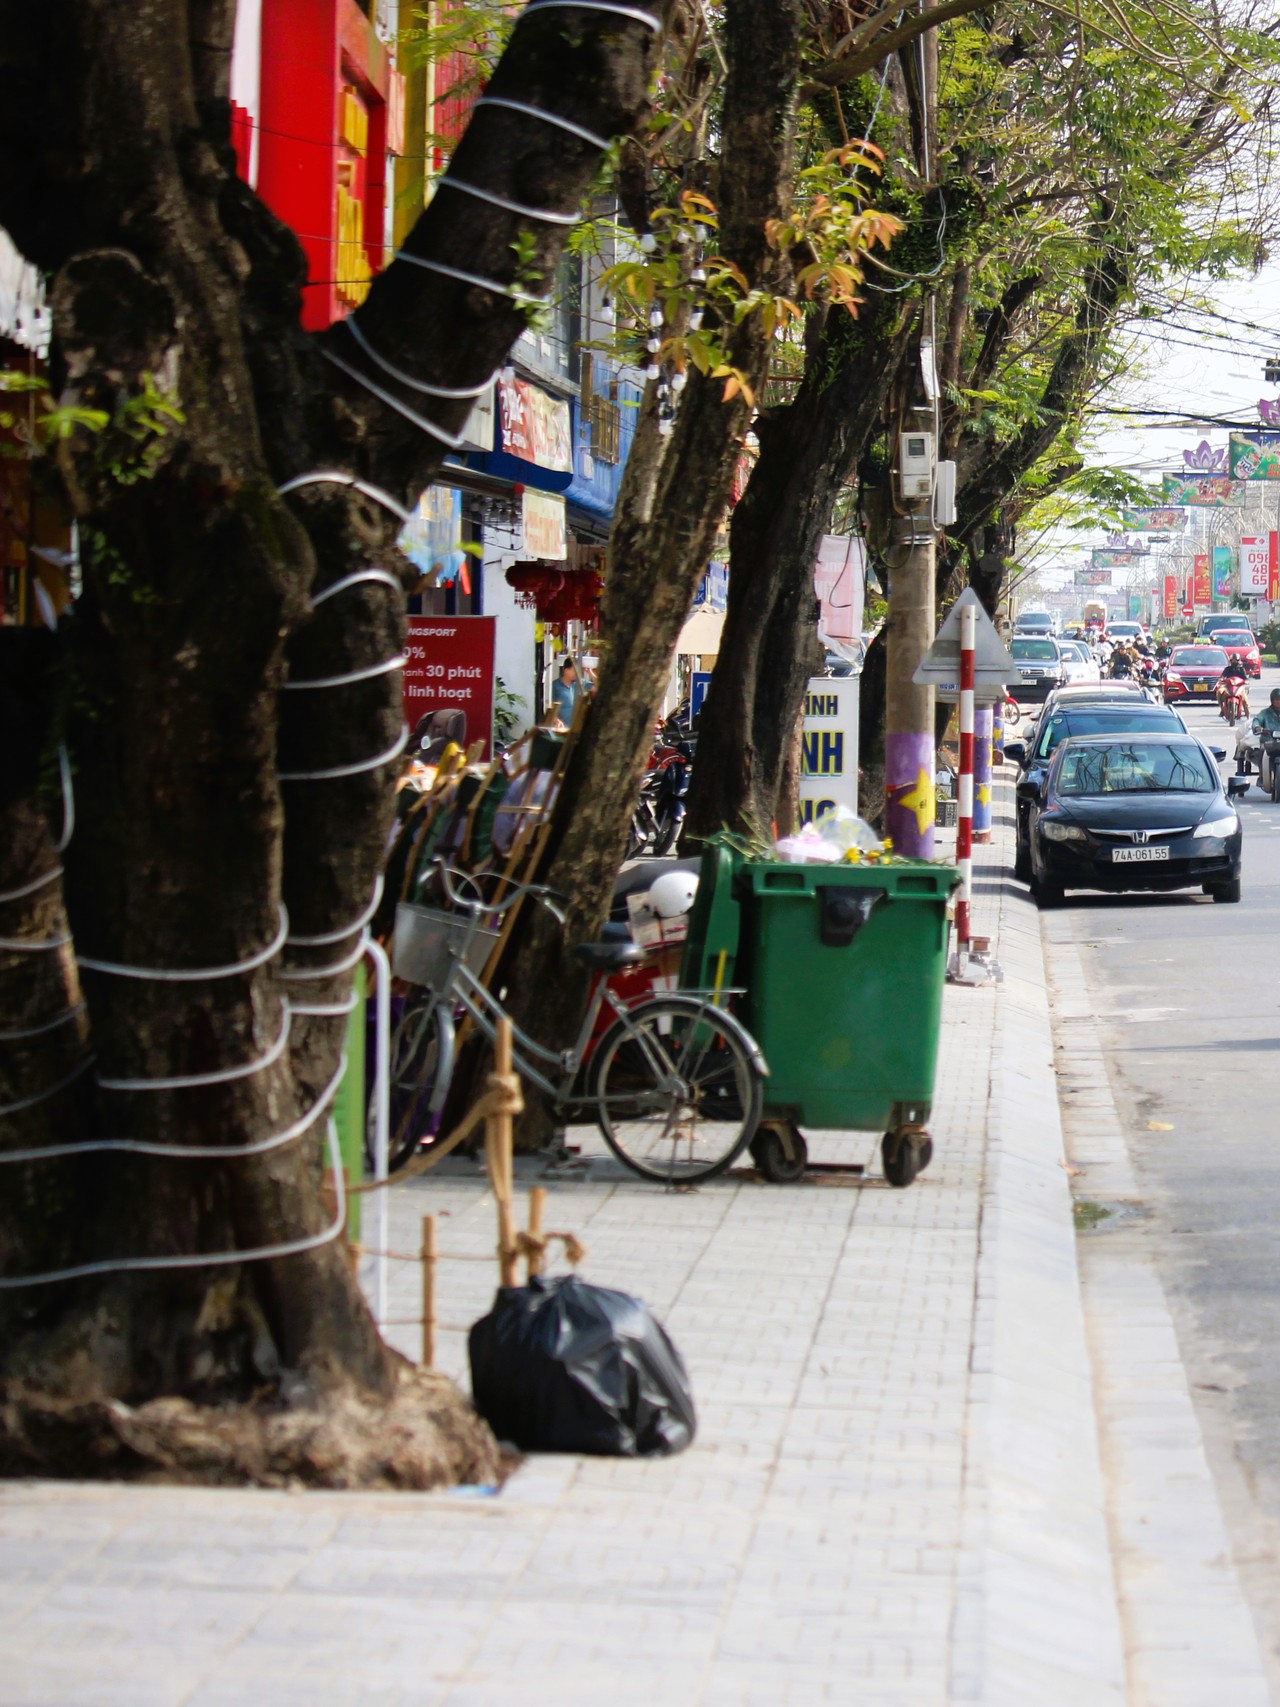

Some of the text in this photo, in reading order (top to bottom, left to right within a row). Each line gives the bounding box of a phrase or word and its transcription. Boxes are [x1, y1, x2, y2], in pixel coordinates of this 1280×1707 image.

[1252, 564, 1268, 575] 48
[1252, 575, 1267, 585] 65
[426, 665, 445, 677] 30
[448, 666, 481, 680] phút
[409, 685, 472, 701] linh hoạt
[1114, 848, 1167, 861] 74A-061.55
